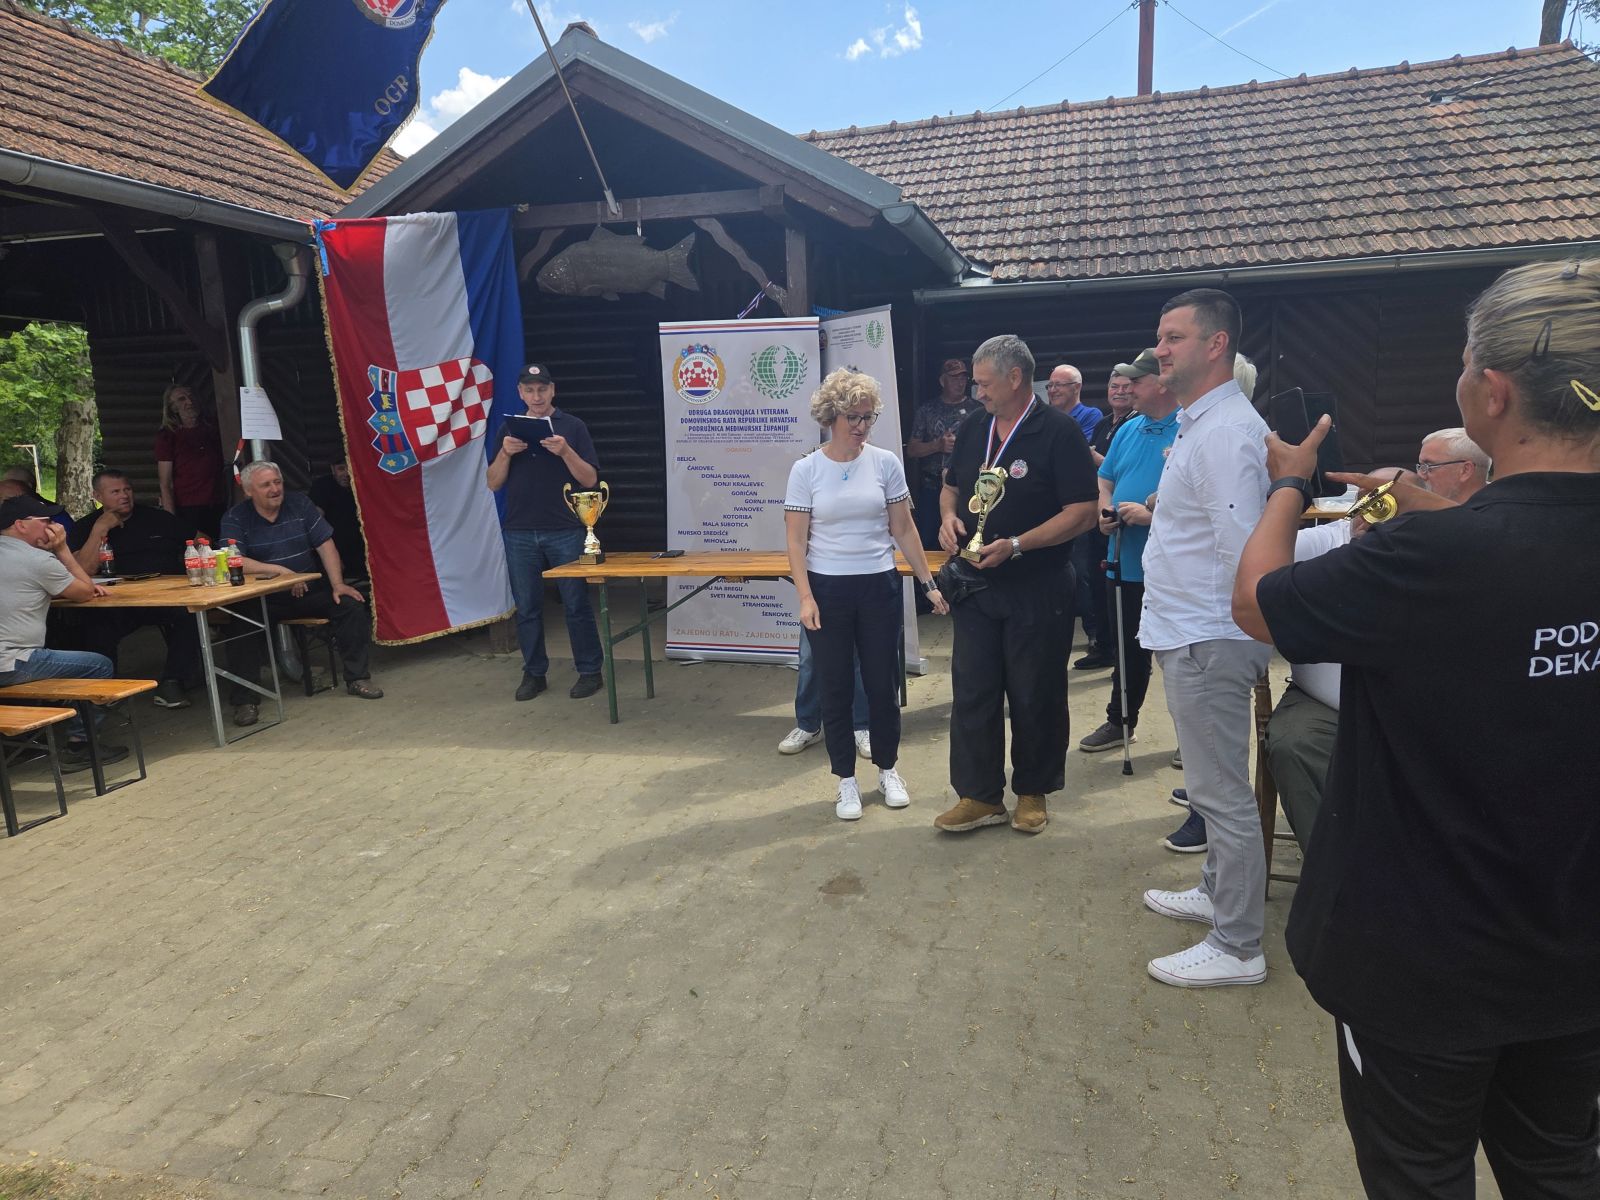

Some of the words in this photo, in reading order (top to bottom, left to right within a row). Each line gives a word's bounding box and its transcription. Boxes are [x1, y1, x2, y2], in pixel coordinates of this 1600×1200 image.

[713, 409, 755, 417] DRAGOVOLJACA
[688, 424, 724, 432] PODRUŽNICA
[763, 424, 789, 433] ŽUPANIJE
[720, 630, 740, 638] RATU
[745, 631, 781, 639] ZAJEDNO
[1534, 621, 1599, 651] POD
